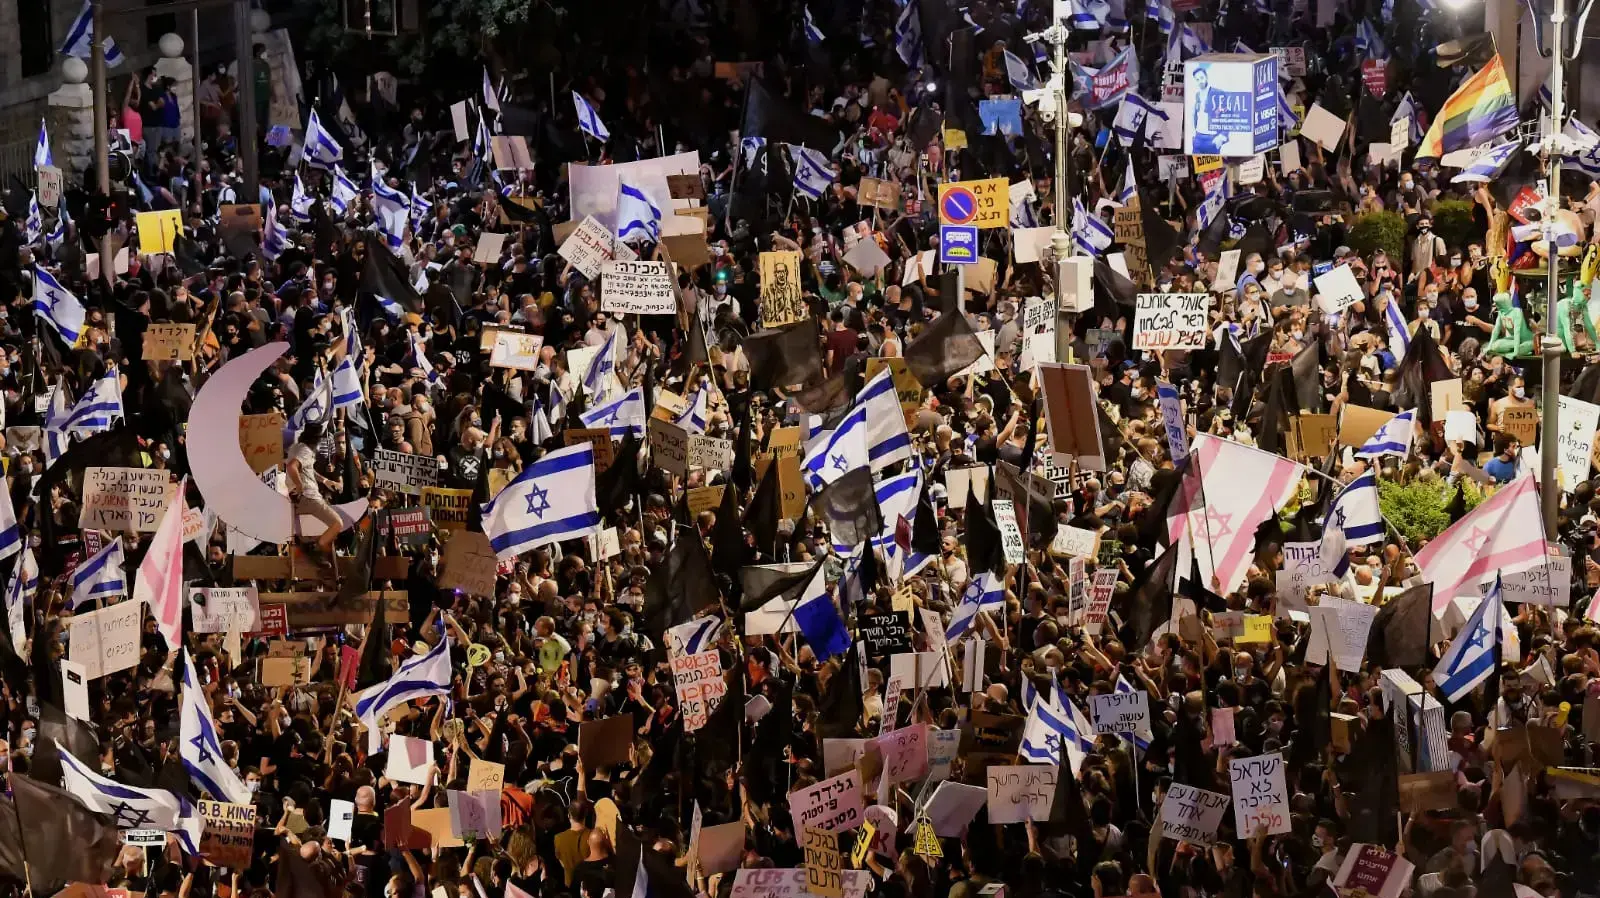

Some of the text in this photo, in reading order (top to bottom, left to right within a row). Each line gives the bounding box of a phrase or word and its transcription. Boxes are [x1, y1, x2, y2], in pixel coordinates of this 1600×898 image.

[1256, 61, 1274, 87] SEGAL
[1211, 94, 1248, 112] SEGAL
[615, 262, 668, 275] למכירה:
[1137, 295, 1206, 311] אמיר אוחנה
[1182, 313, 1205, 327] השר
[92, 467, 116, 480] כולה
[870, 614, 898, 625] תמיד
[885, 625, 905, 635] הכי
[675, 653, 719, 672] הנאשם
[1119, 712, 1144, 722] עושה
[1232, 758, 1280, 781] ישראל
[809, 778, 854, 805] גלידה
[988, 773, 1020, 798] חושך
[1251, 778, 1272, 794] לא
[1011, 788, 1048, 806] לגרש
[1168, 786, 1228, 810] אנחנו עם
[1240, 793, 1281, 808] צריכה
[198, 801, 255, 821] B.B. KING
[800, 798, 838, 824] פיסטוק
[1178, 802, 1205, 821] אחד
[805, 827, 838, 851] בגלל
[806, 848, 839, 871] שנאת
[1366, 848, 1391, 860] הם לא
[807, 867, 841, 889] חינם
